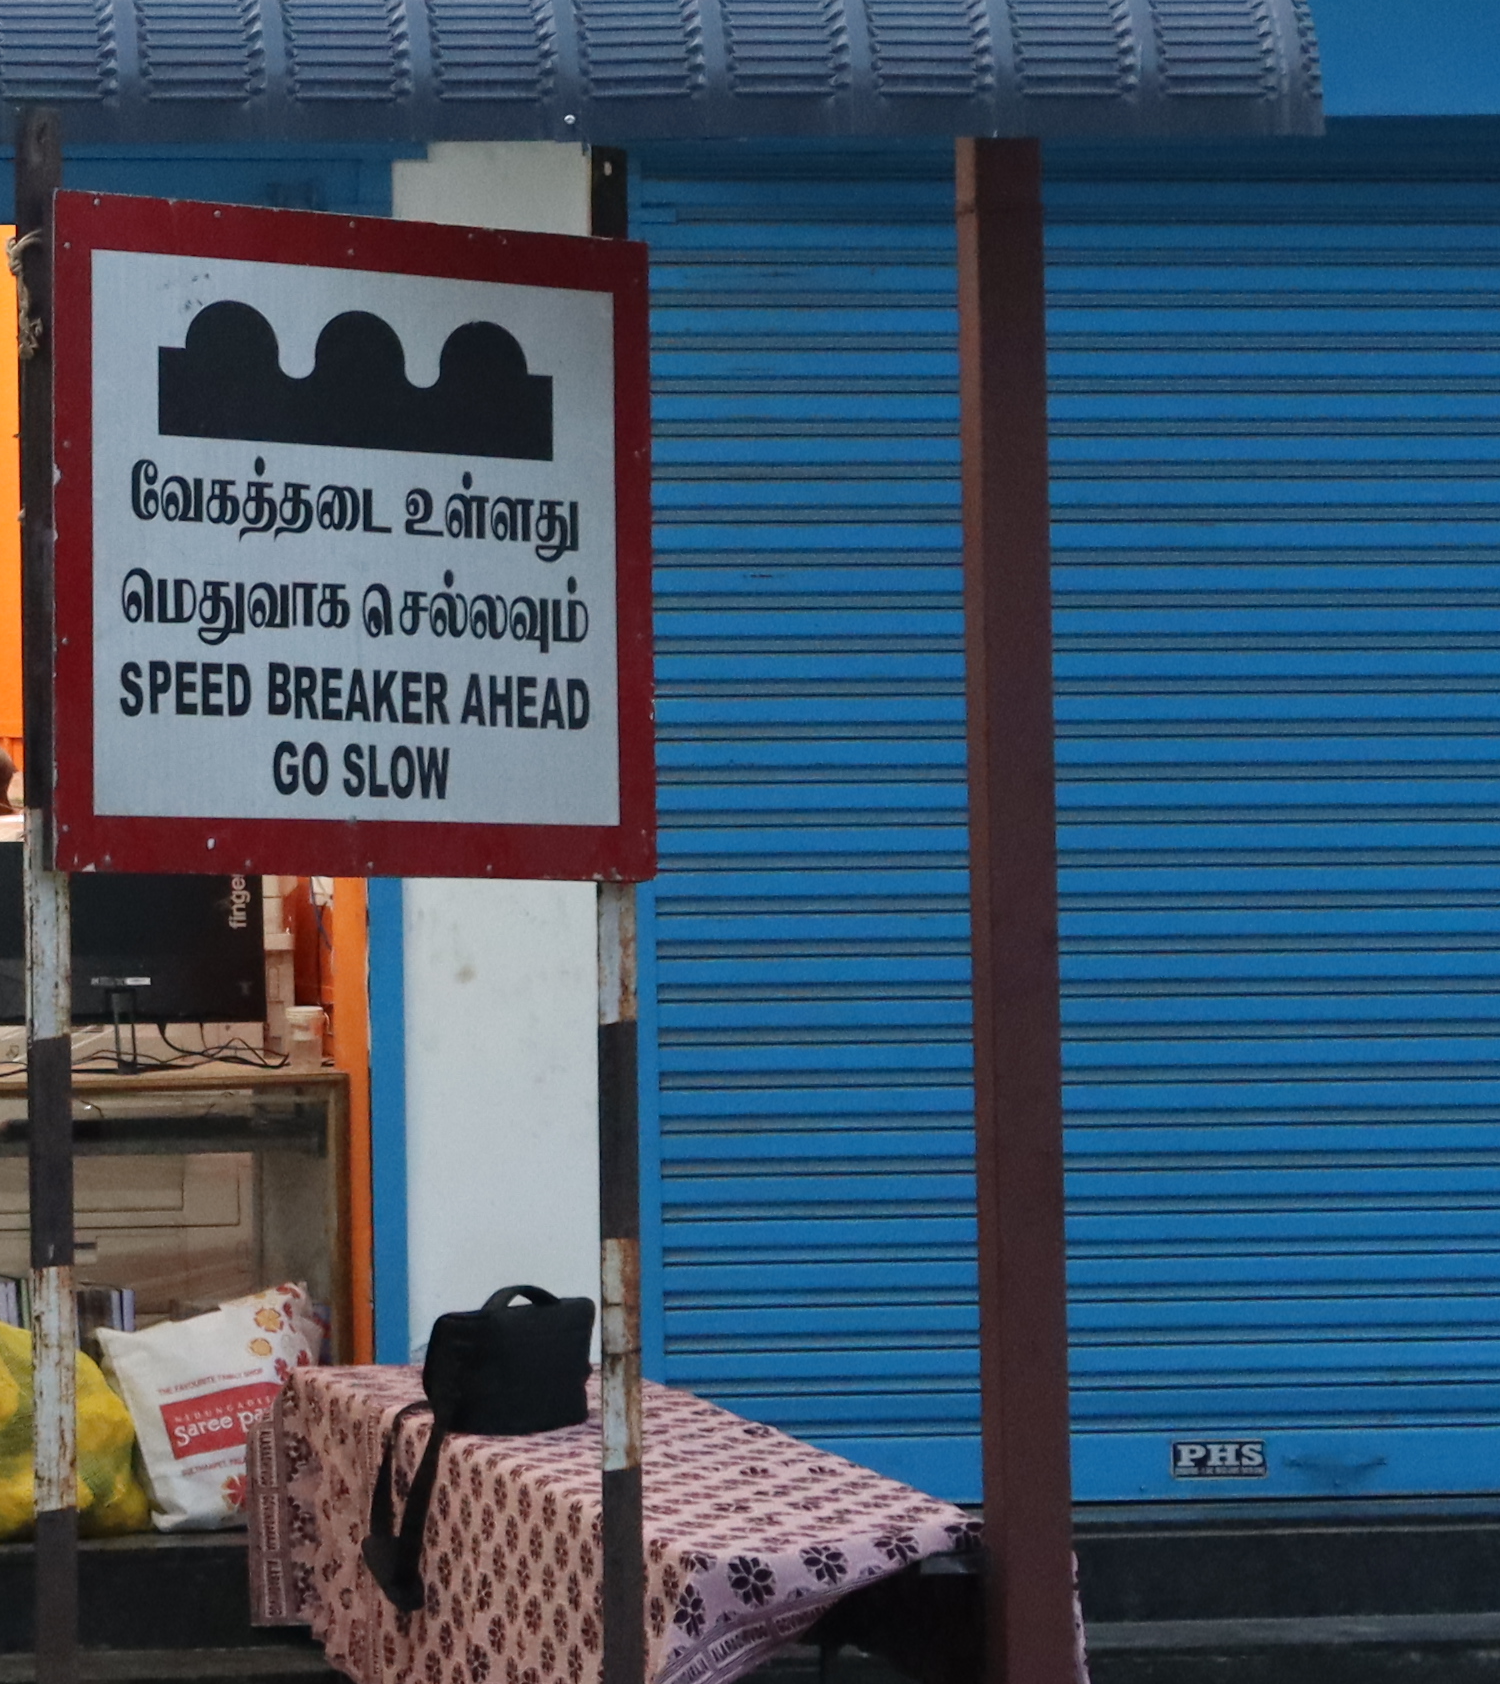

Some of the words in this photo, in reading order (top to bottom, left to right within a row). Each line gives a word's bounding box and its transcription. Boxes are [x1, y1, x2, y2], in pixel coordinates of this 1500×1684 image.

[132, 456, 392, 540] வேகத்தடை
[405, 472, 578, 562] உள்ளது
[122, 568, 350, 645] மெதுவாக
[362, 570, 588, 653] செல்லவும்
[120, 661, 251, 716] SPEED
[268, 662, 449, 724] BREAKER
[461, 674, 589, 730] AHEAD
[273, 741, 328, 796] GO
[343, 744, 449, 799] SLOW
[174, 1415, 234, 1447] Saree
[237, 1408, 266, 1433] pa
[1178, 1444, 1262, 1466] PHS
